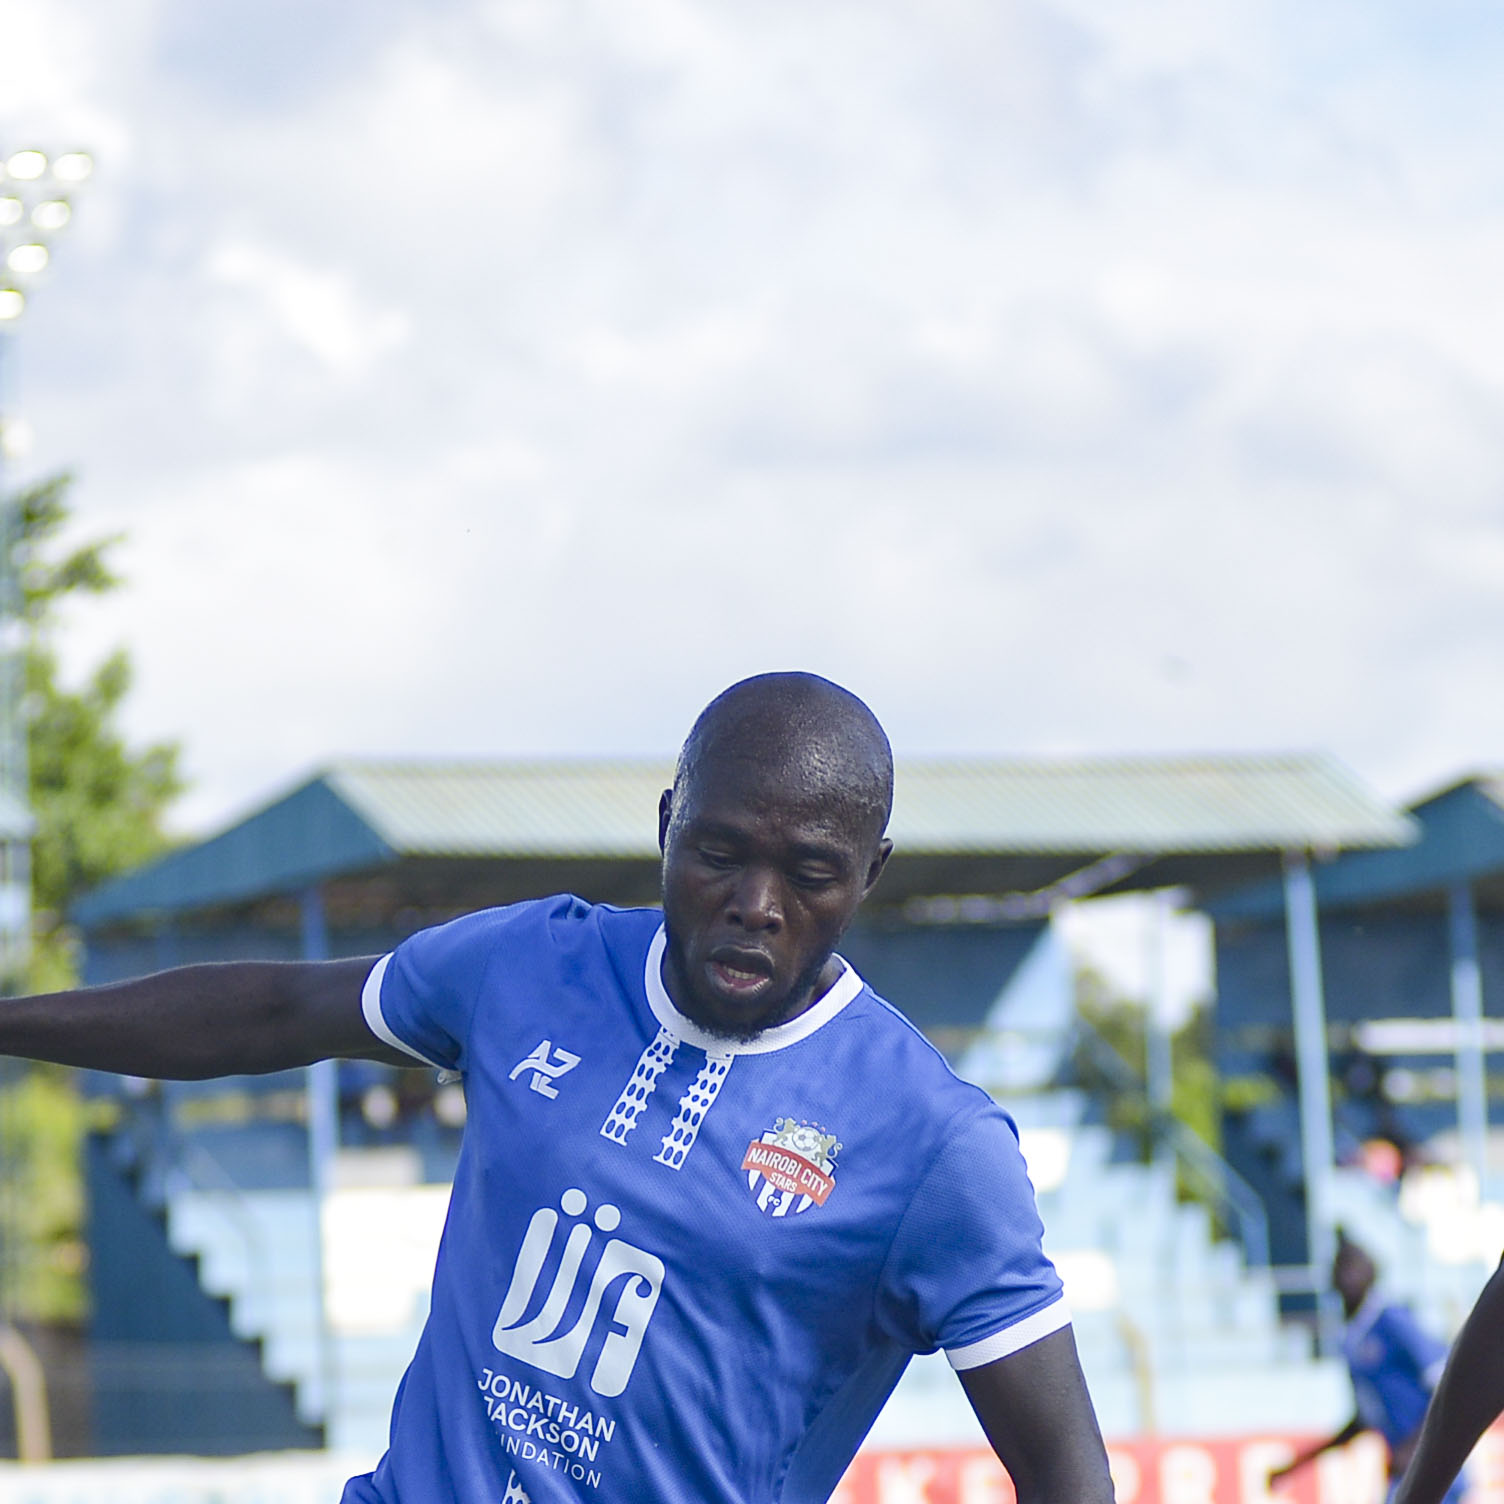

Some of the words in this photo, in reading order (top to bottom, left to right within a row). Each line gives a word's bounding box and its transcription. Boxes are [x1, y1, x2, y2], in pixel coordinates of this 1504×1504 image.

[747, 1147, 802, 1179] NAIROBI
[801, 1169, 828, 1196] CITY
[769, 1171, 798, 1193] STARS
[477, 1368, 616, 1442] JONATHAN
[484, 1396, 600, 1462] JACKSON
[500, 1433, 601, 1489] NDATION
